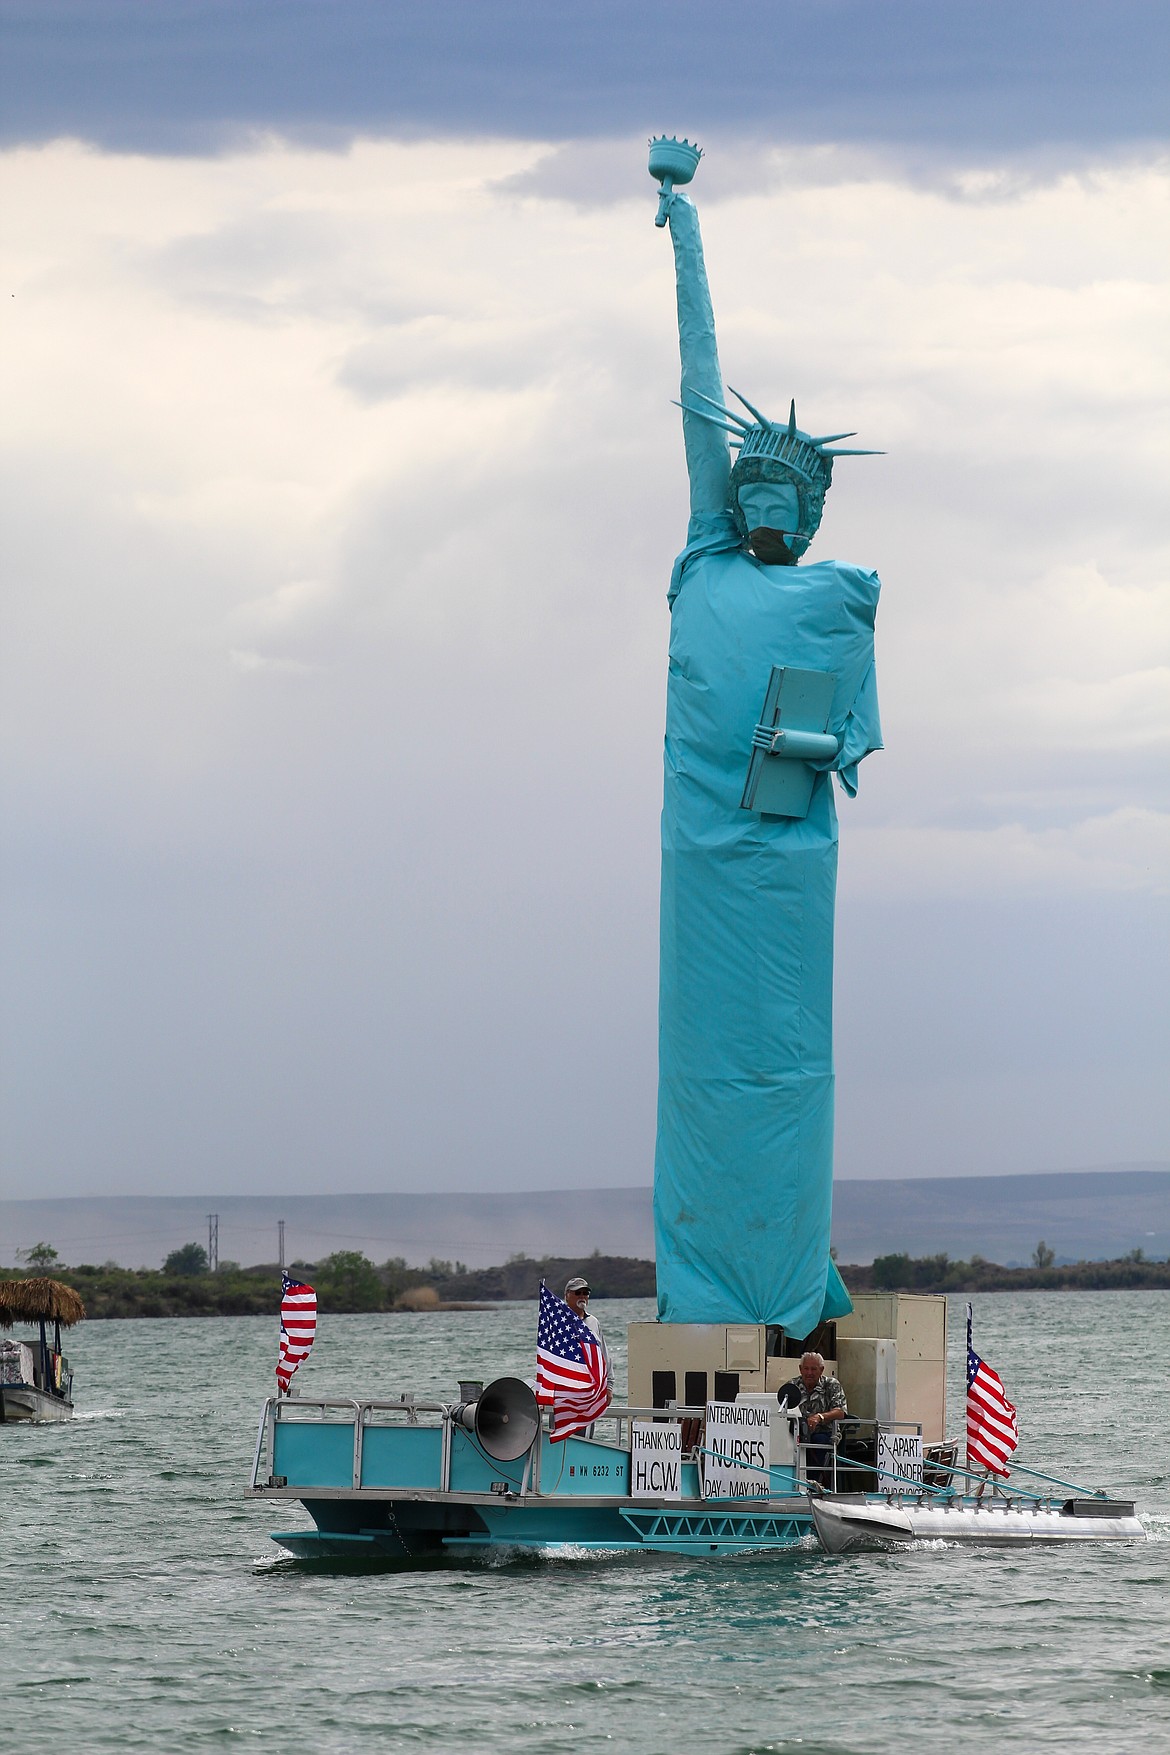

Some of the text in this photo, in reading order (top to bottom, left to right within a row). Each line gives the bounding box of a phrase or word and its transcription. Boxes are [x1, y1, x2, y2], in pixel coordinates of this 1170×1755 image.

[706, 1405, 770, 1426] INTERNATIONAL
[633, 1431, 682, 1451] THANK YOU
[711, 1437, 765, 1469] NURSES
[579, 1465, 624, 1477] WN 6232 ST
[636, 1461, 678, 1492] H.C.W.
[892, 1462, 923, 1482] UNDER
[729, 1480, 749, 1498] MAY
[750, 1481, 770, 1499] 12th
